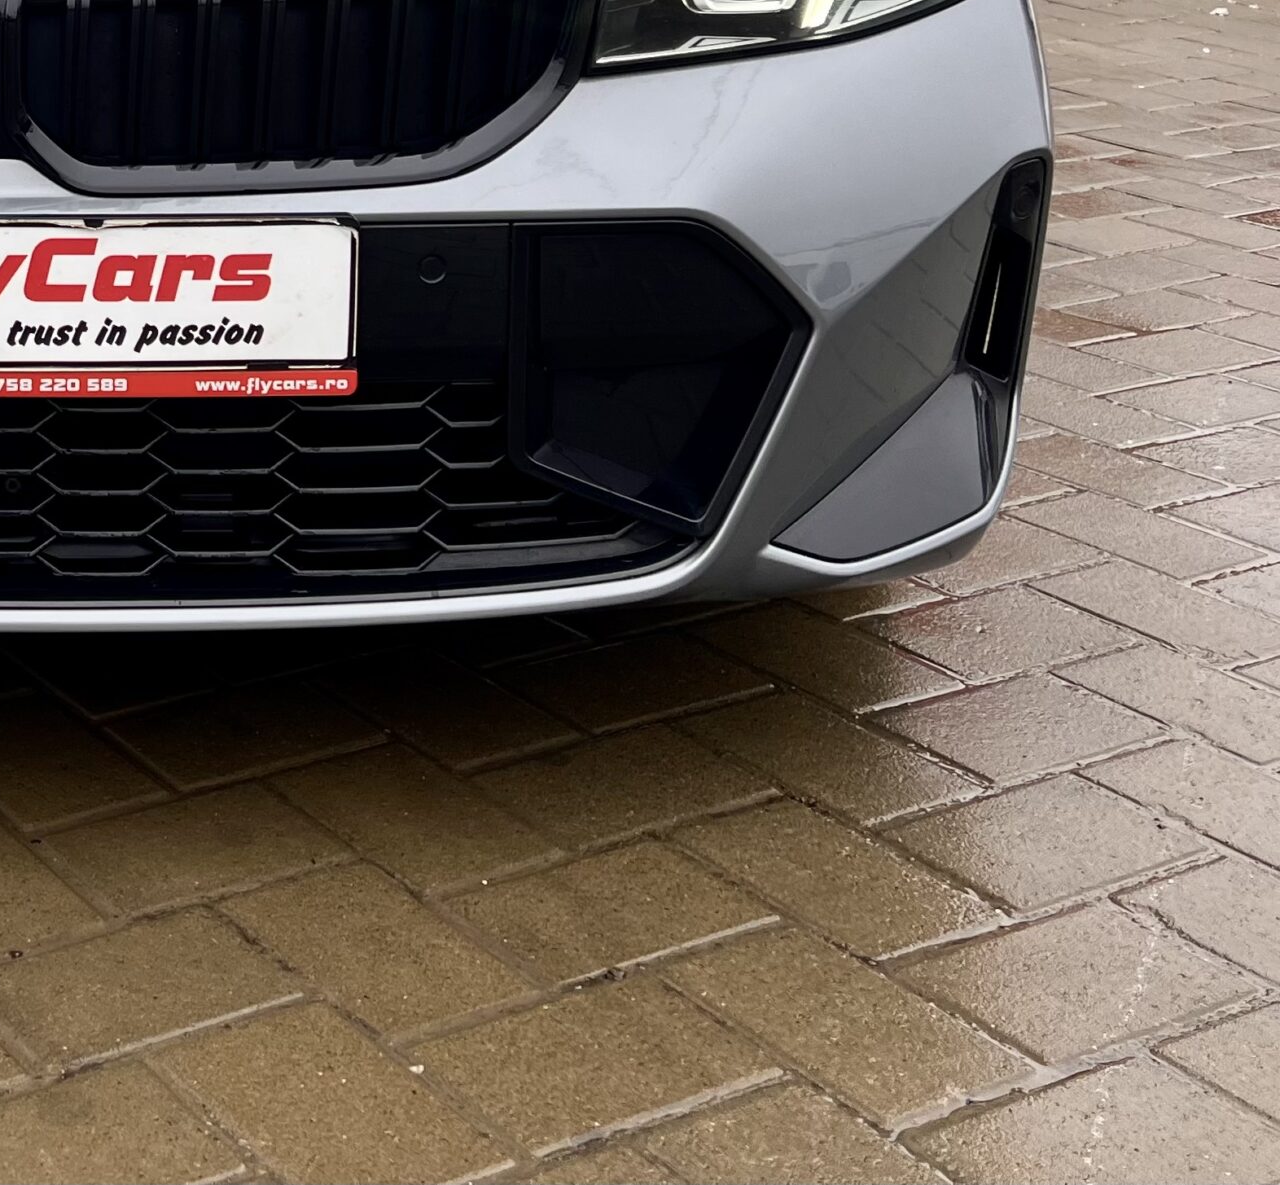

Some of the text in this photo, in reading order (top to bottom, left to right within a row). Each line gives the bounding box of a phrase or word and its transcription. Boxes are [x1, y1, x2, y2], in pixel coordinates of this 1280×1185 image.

[6, 316, 265, 353] trust in passion
[39, 378, 81, 392] 220
[87, 378, 128, 392] 589
[195, 377, 349, 395] www.flycars.ro
